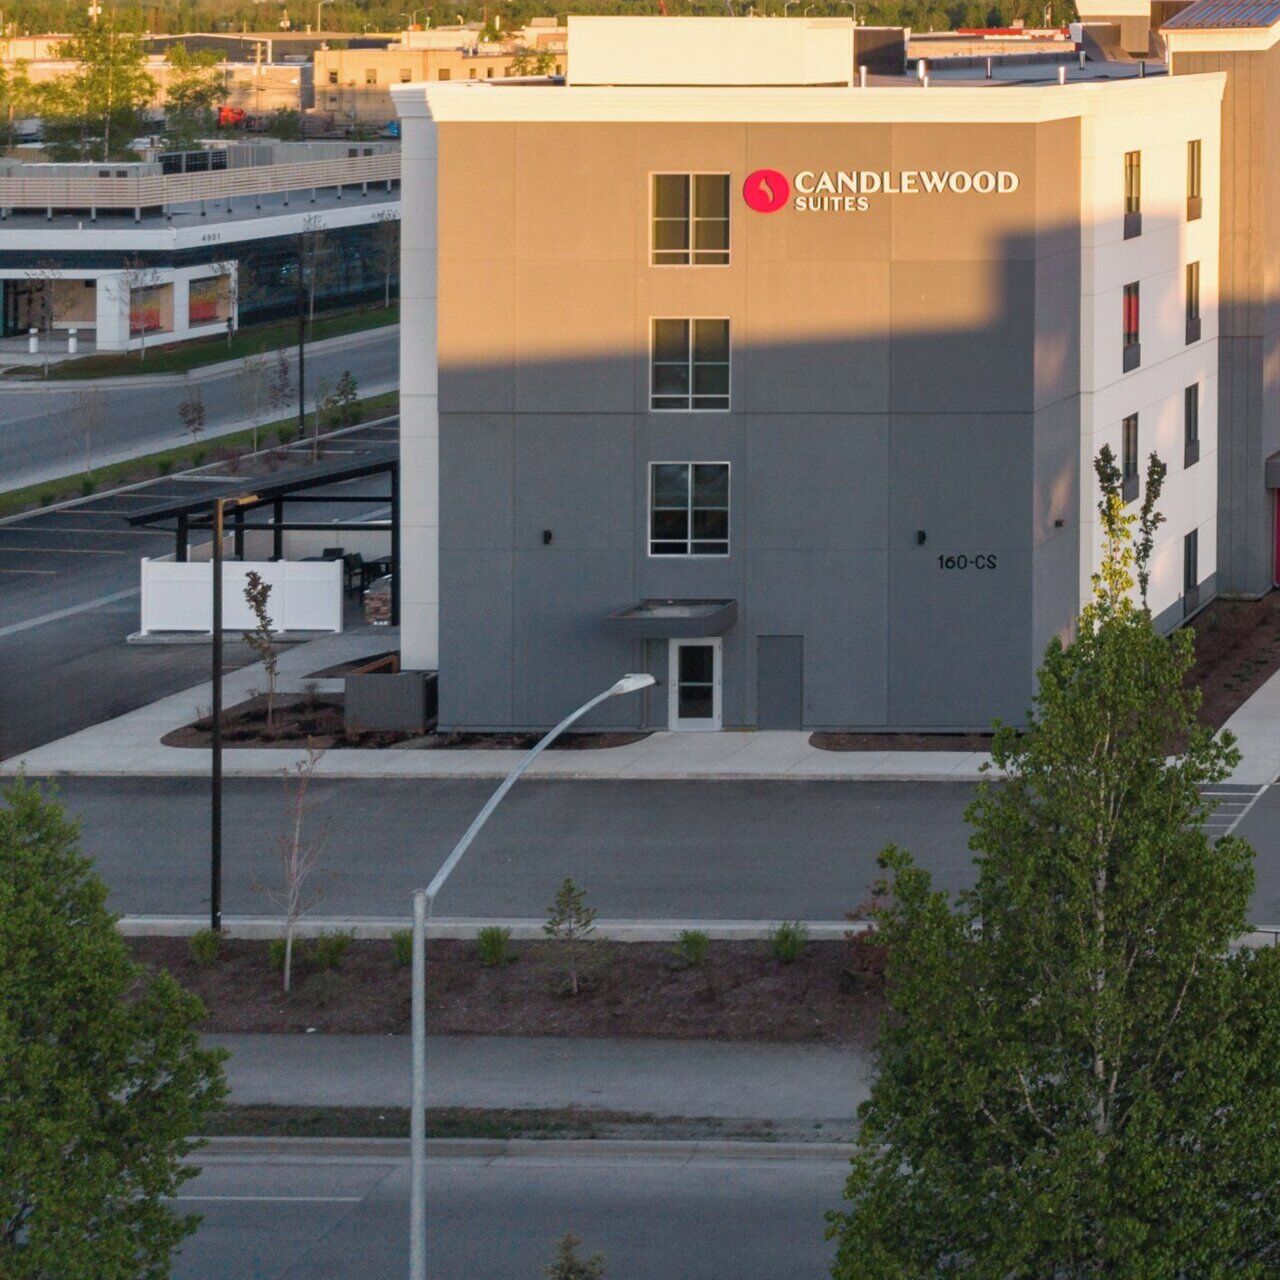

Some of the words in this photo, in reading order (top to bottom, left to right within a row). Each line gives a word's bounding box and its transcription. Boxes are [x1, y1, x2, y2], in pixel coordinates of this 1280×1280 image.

[794, 170, 1019, 193] CANDLEWOOD
[794, 196, 869, 211] SUITES
[938, 554, 997, 569] 160-CS
